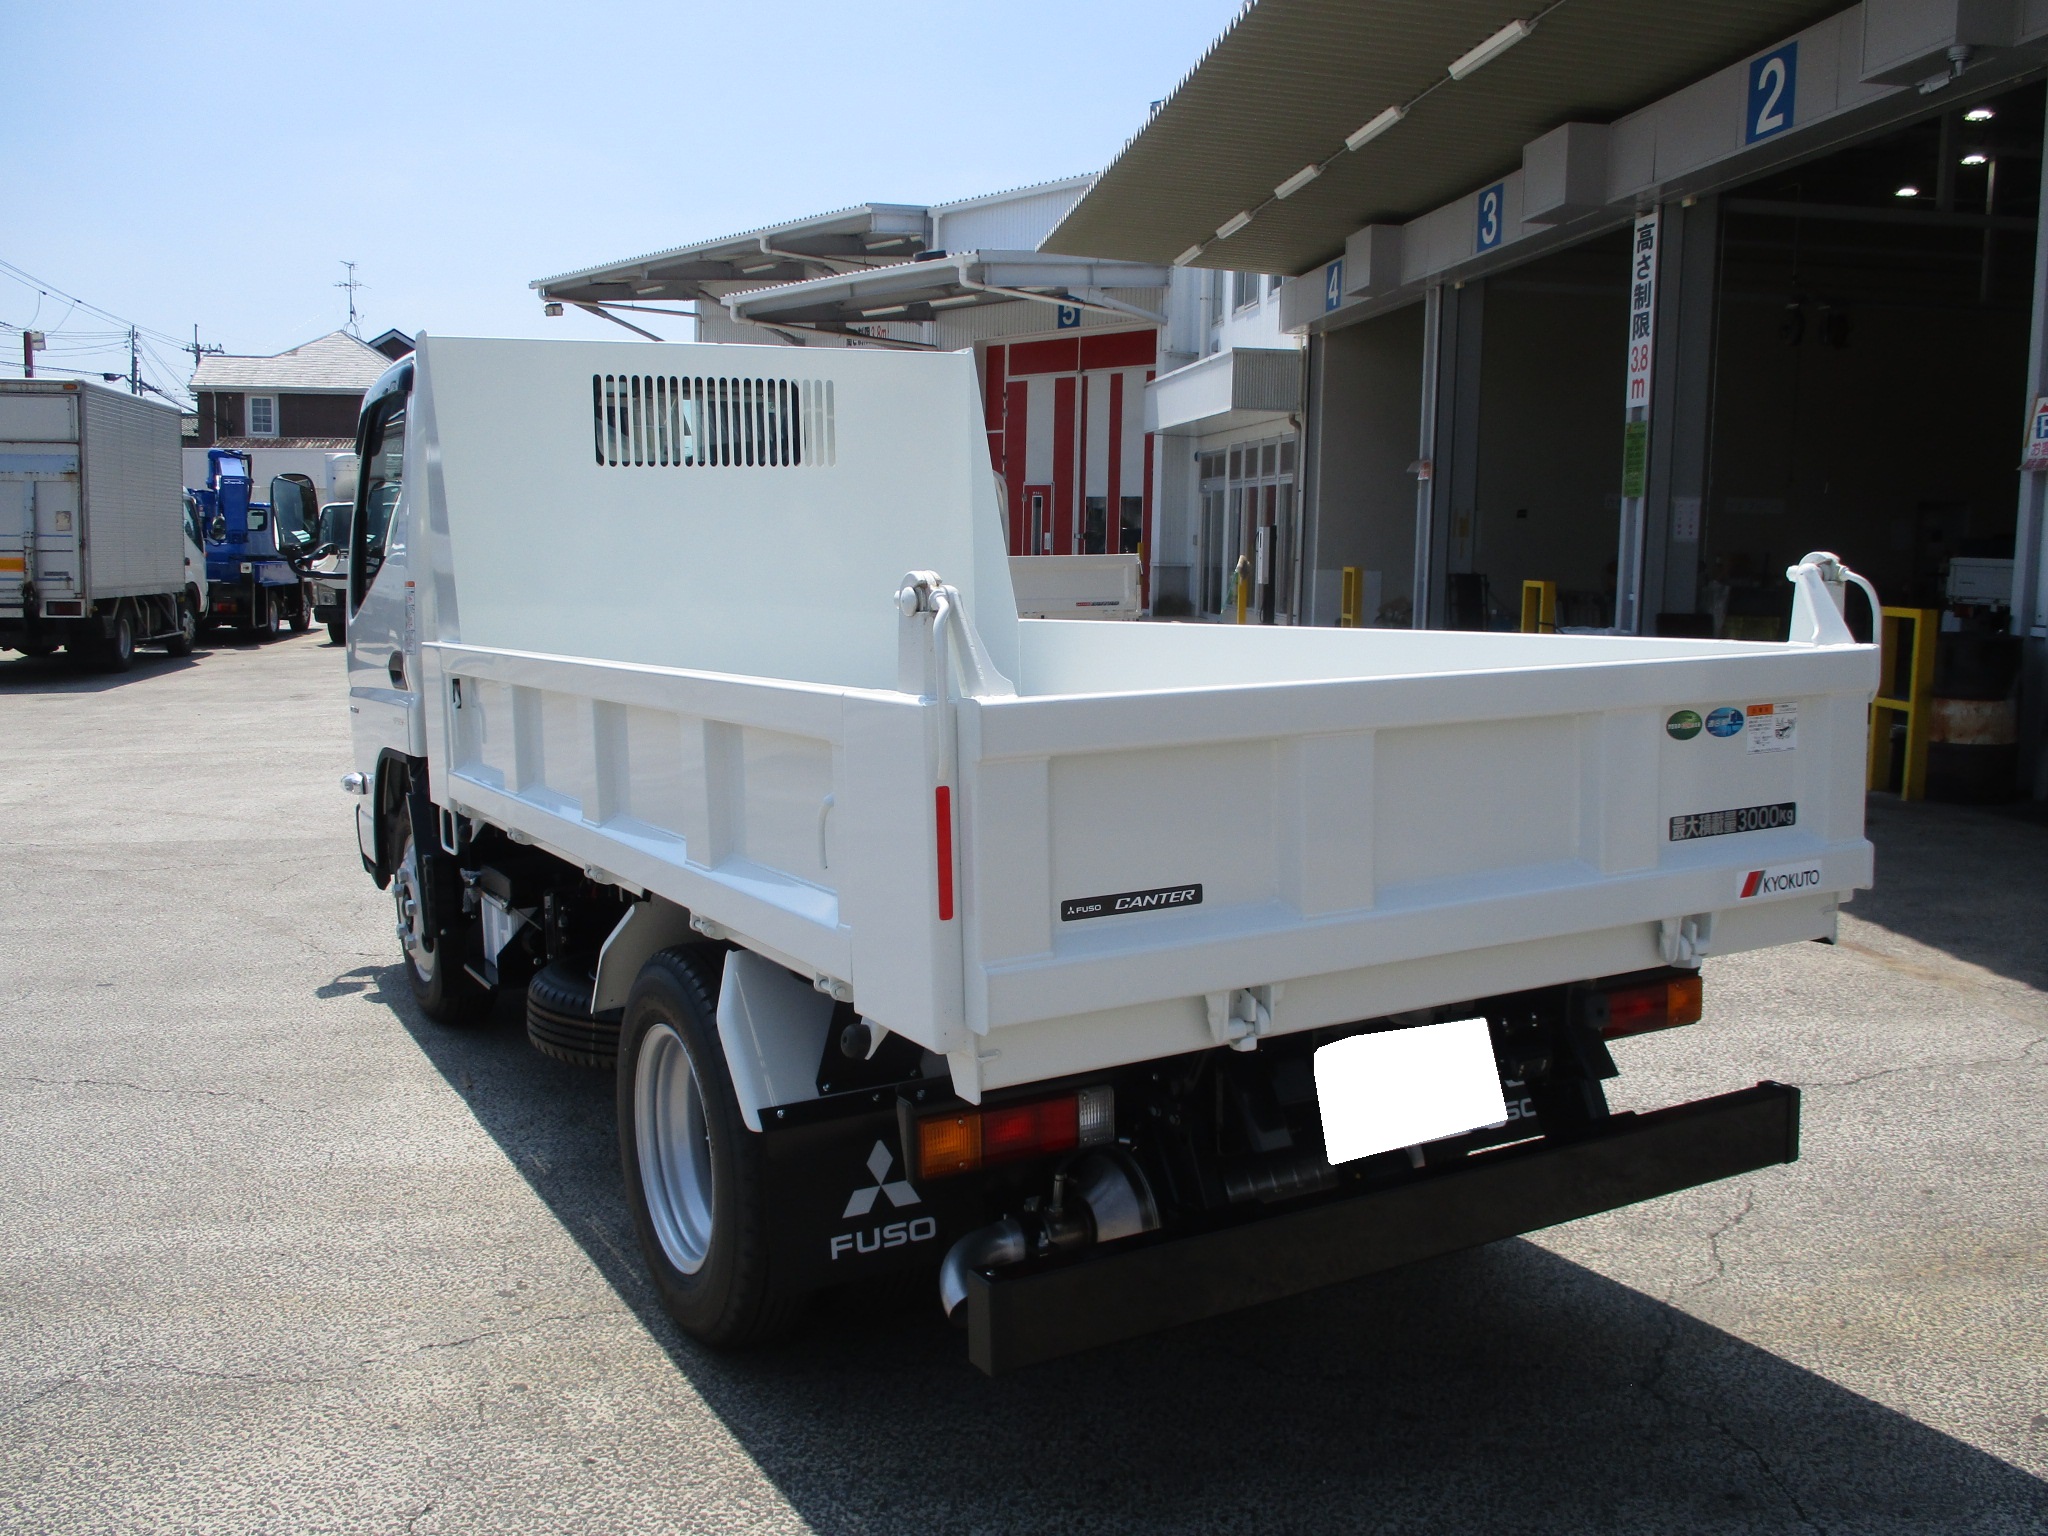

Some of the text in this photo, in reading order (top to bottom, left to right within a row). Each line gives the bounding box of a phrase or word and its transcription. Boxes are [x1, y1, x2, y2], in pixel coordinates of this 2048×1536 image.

[1756, 57, 1785, 135] 2
[1482, 192, 1497, 244] 3
[1328, 266, 1339, 306] 4
[1062, 304, 1076, 325] 5
[1076, 889, 1195, 914] FUSO CANTER
[1763, 870, 1820, 893] KYOKUTO
[831, 1216, 936, 1260] FUSO
